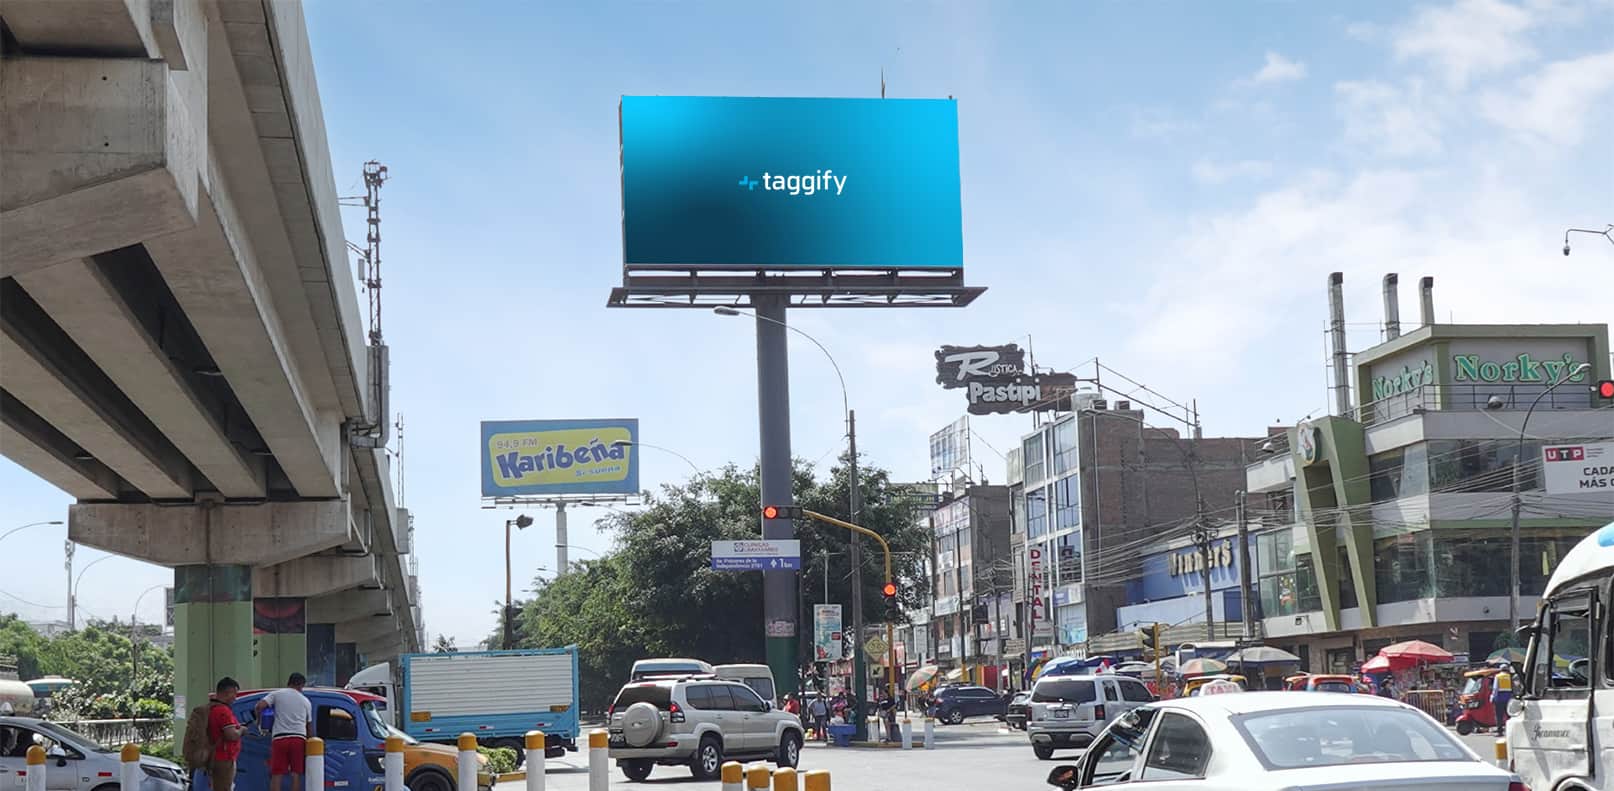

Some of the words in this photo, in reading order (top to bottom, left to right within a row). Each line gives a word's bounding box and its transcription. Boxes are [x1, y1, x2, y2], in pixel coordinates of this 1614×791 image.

[762, 169, 847, 195] taggify
[1454, 352, 1585, 386] Norky's
[495, 438, 625, 479] Karibeña
[1547, 449, 1582, 459] UTP
[1583, 466, 1614, 476] CADA
[1579, 476, 1607, 488] MÁS
[779, 558, 784, 568] 1
[1029, 549, 1043, 619] DENTAL
